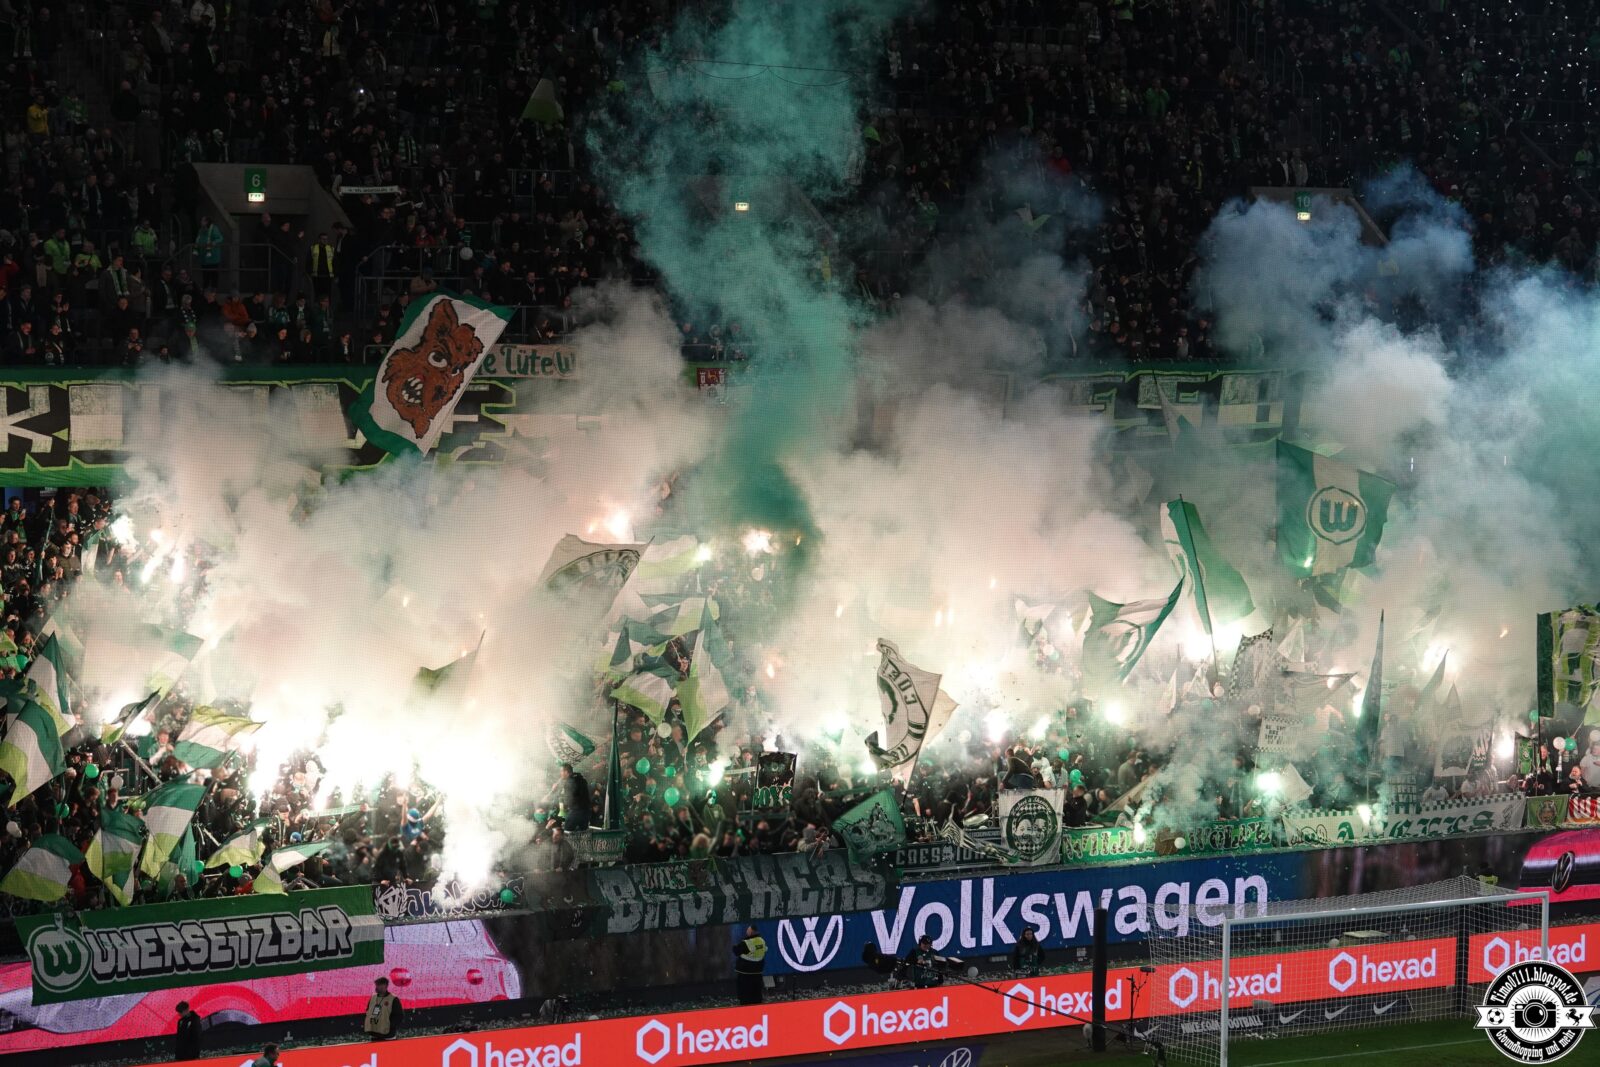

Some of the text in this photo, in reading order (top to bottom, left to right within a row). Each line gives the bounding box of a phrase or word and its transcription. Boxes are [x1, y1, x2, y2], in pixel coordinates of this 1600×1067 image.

[251, 174, 261, 188] 6
[1297, 196, 1311, 208] 10
[871, 875, 1268, 955] Volkswagen
[83, 906, 353, 983] UNERSETZBAR
[1361, 948, 1437, 984] hexad
[862, 996, 949, 1036] hexad
[1040, 979, 1122, 1017] hexd
[485, 1033, 581, 1067] hexad
[677, 1015, 768, 1055] hexad
